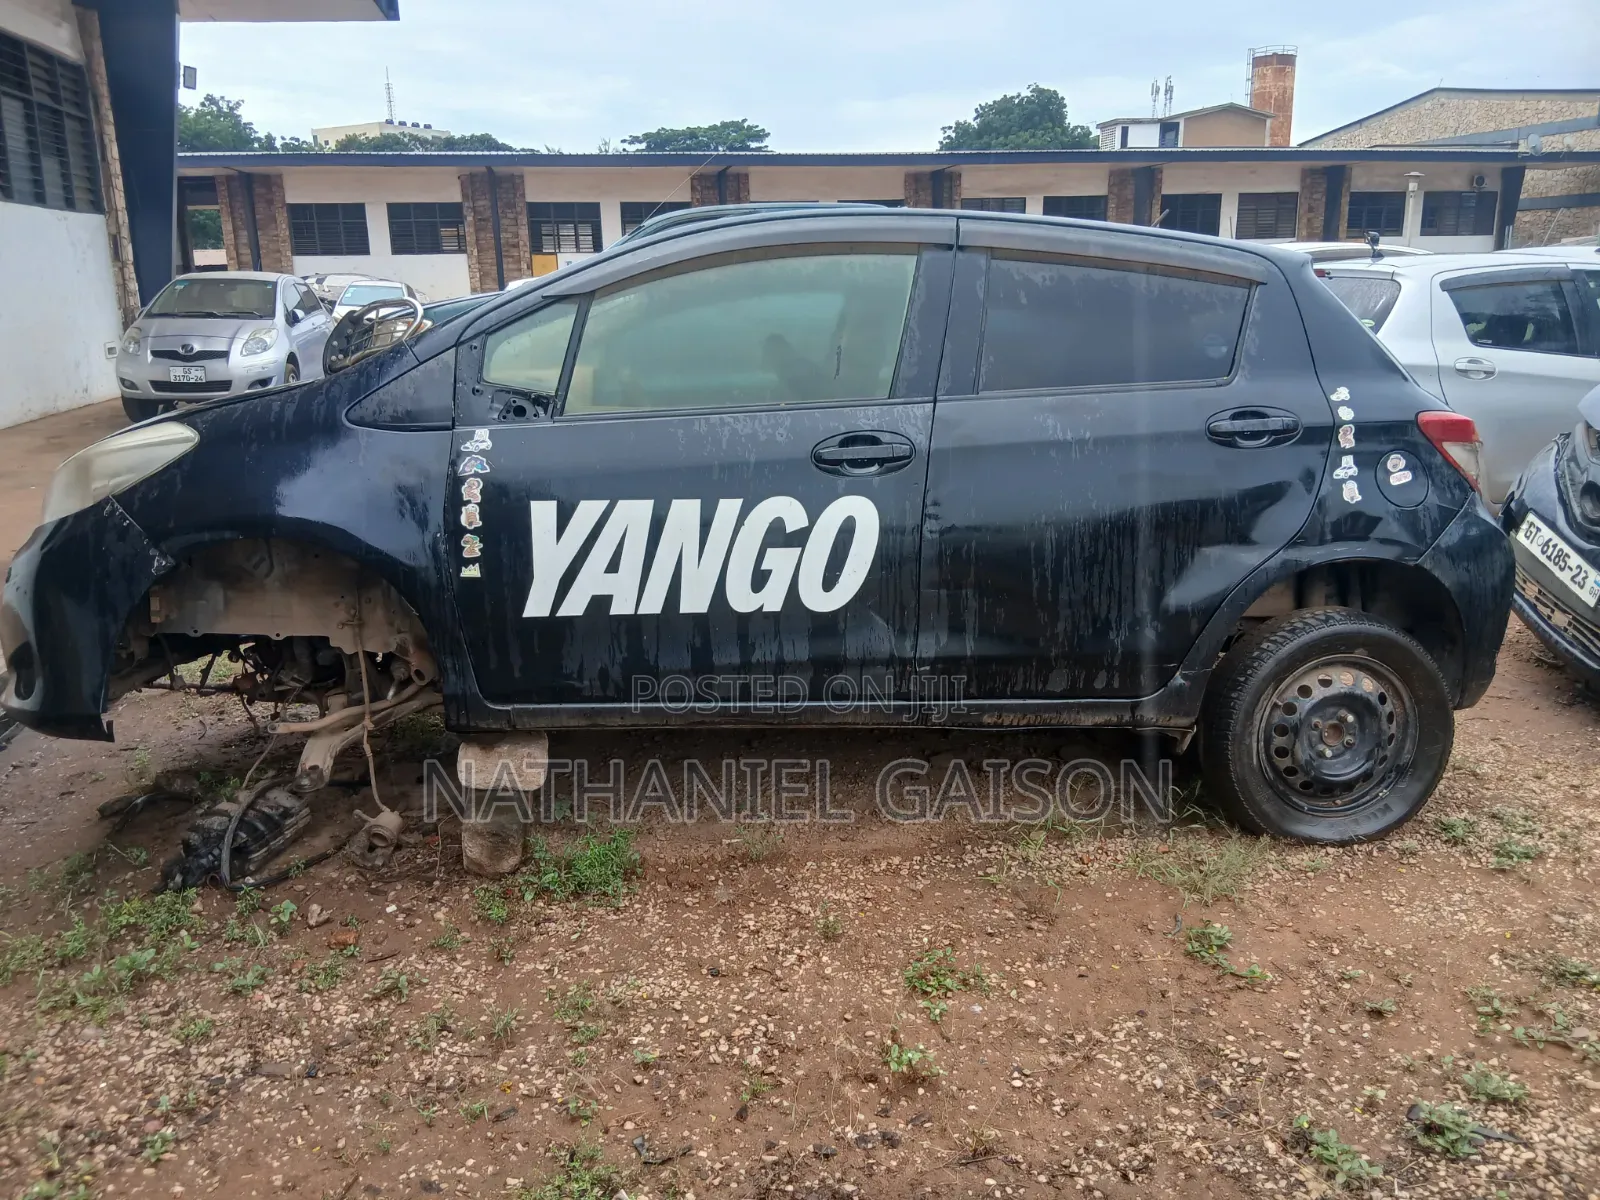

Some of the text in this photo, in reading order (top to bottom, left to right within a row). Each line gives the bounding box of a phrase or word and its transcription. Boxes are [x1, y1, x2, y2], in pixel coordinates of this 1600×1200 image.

[522, 495, 880, 617] YANGO
[1524, 521, 1589, 589] GT 6185-23
